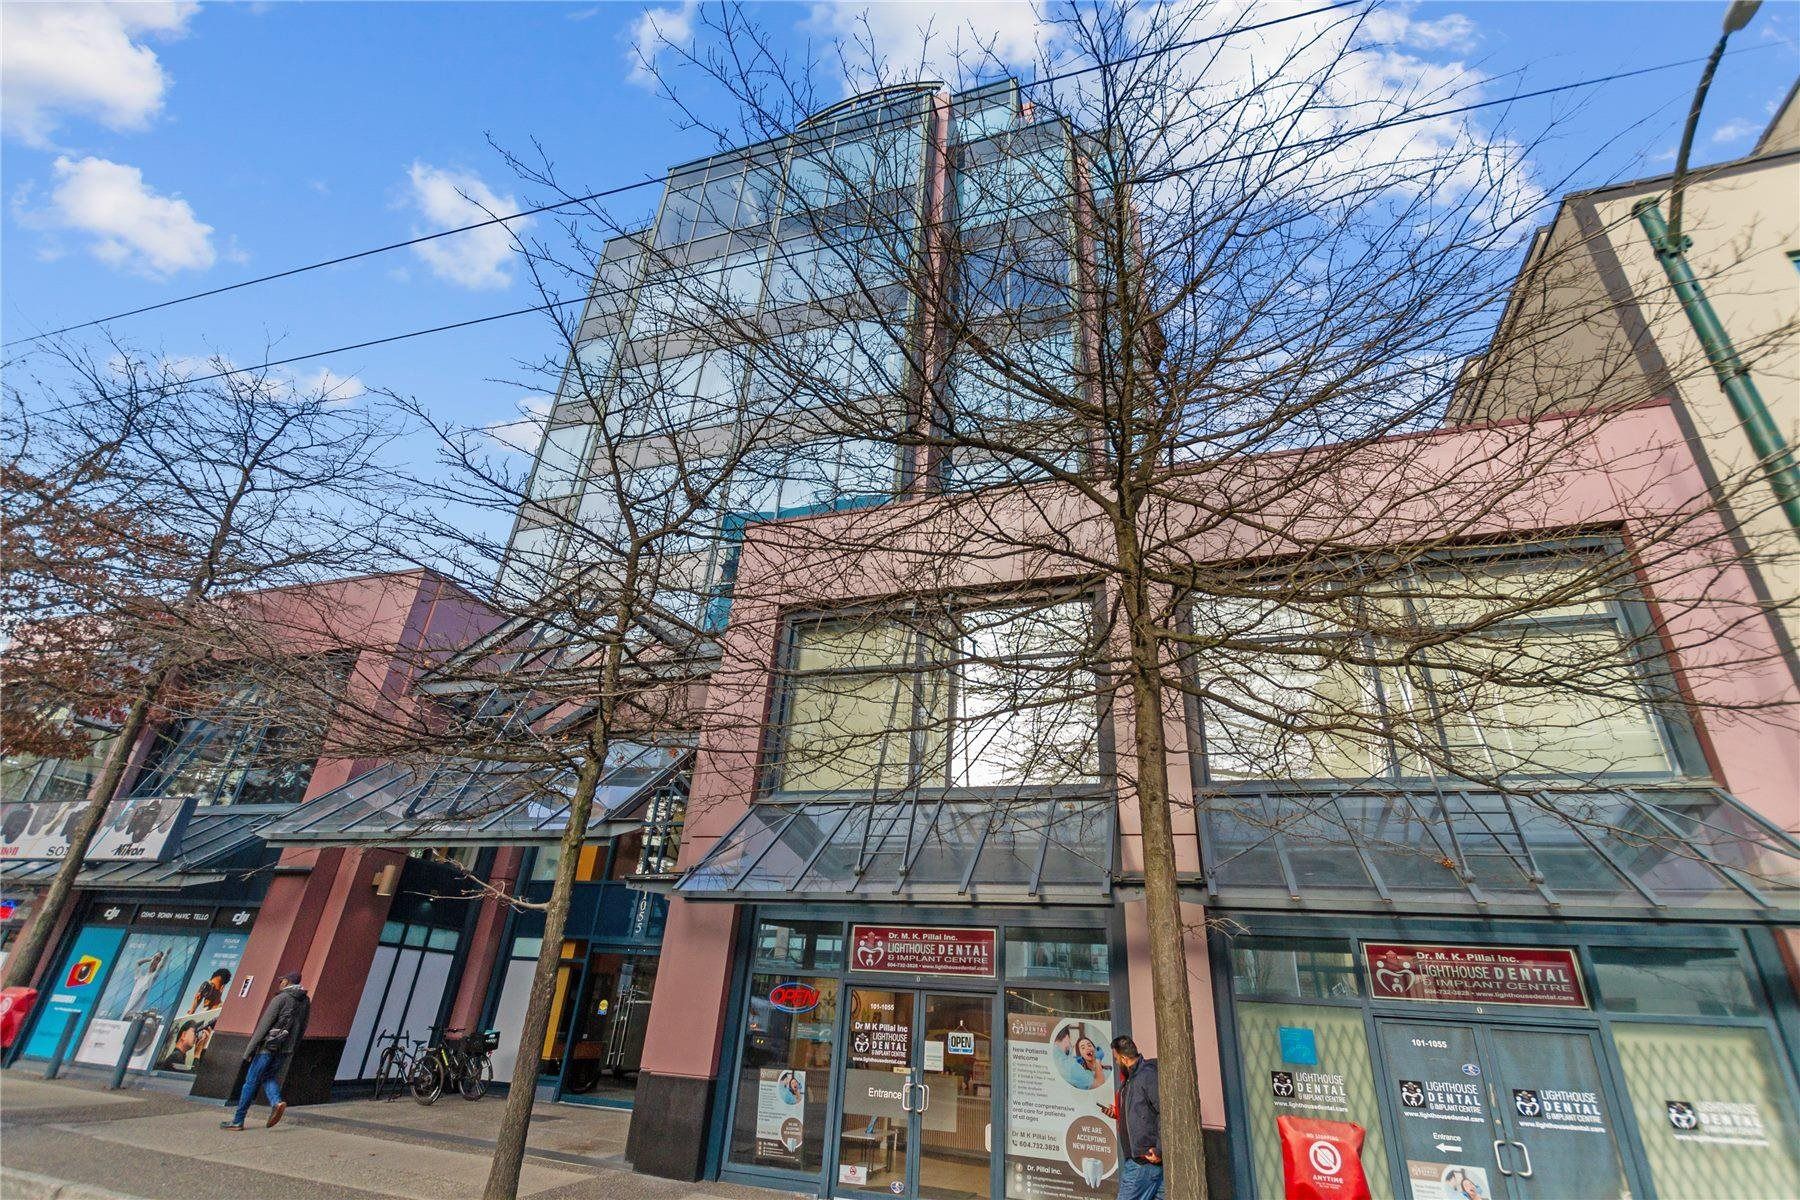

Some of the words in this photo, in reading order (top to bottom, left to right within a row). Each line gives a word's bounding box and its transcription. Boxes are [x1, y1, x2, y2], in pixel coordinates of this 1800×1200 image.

[111, 843, 146, 856] Nikon
[888, 942, 935, 955] LIGHTHOUSE
[938, 944, 988, 956] DENTAL
[1466, 954, 1495, 962] Pillai
[1498, 955, 1520, 964] Inc.
[1419, 964, 1491, 979] LIGHTHOUSE
[1494, 967, 1569, 983] DENTAL
[1435, 979, 1502, 990] IMPLANT
[1506, 982, 1572, 992] CENTRE
[770, 988, 820, 1007] OPEN
[872, 1033, 907, 1042] LIGHTHOUSE
[951, 1036, 971, 1048] OPEN
[1411, 1039, 1447, 1048] 101-1055
[872, 1041, 907, 1051] DENTAL
[1295, 1072, 1344, 1085] LIGHTHOUSE
[868, 1088, 902, 1100] Entrance
[1297, 1083, 1346, 1096] DENTAL
[1425, 1081, 1478, 1095] LIGHTHOUSE
[1428, 1092, 1481, 1106] DENTAL
[1540, 1090, 1597, 1104] LIGHTHOUSE
[1035, 1103, 1075, 1112] comprehensive
[1435, 1103, 1458, 1112] IMPLANT
[1459, 1105, 1482, 1114] CENTRE
[1543, 1101, 1601, 1115] DENTAL
[1552, 1113, 1577, 1122] IMPLANT
[1578, 1114, 1602, 1124] CENTRE
[1699, 1112, 1763, 1128] DENTAL
[1077, 1134, 1107, 1143] ACCEPTING
[1432, 1132, 1462, 1142] Entrance
[1019, 1140, 1060, 1152] 604.732.3828
[1086, 1144, 1111, 1153] PATIENTS
[1313, 1175, 1344, 1184] ANYTIME
